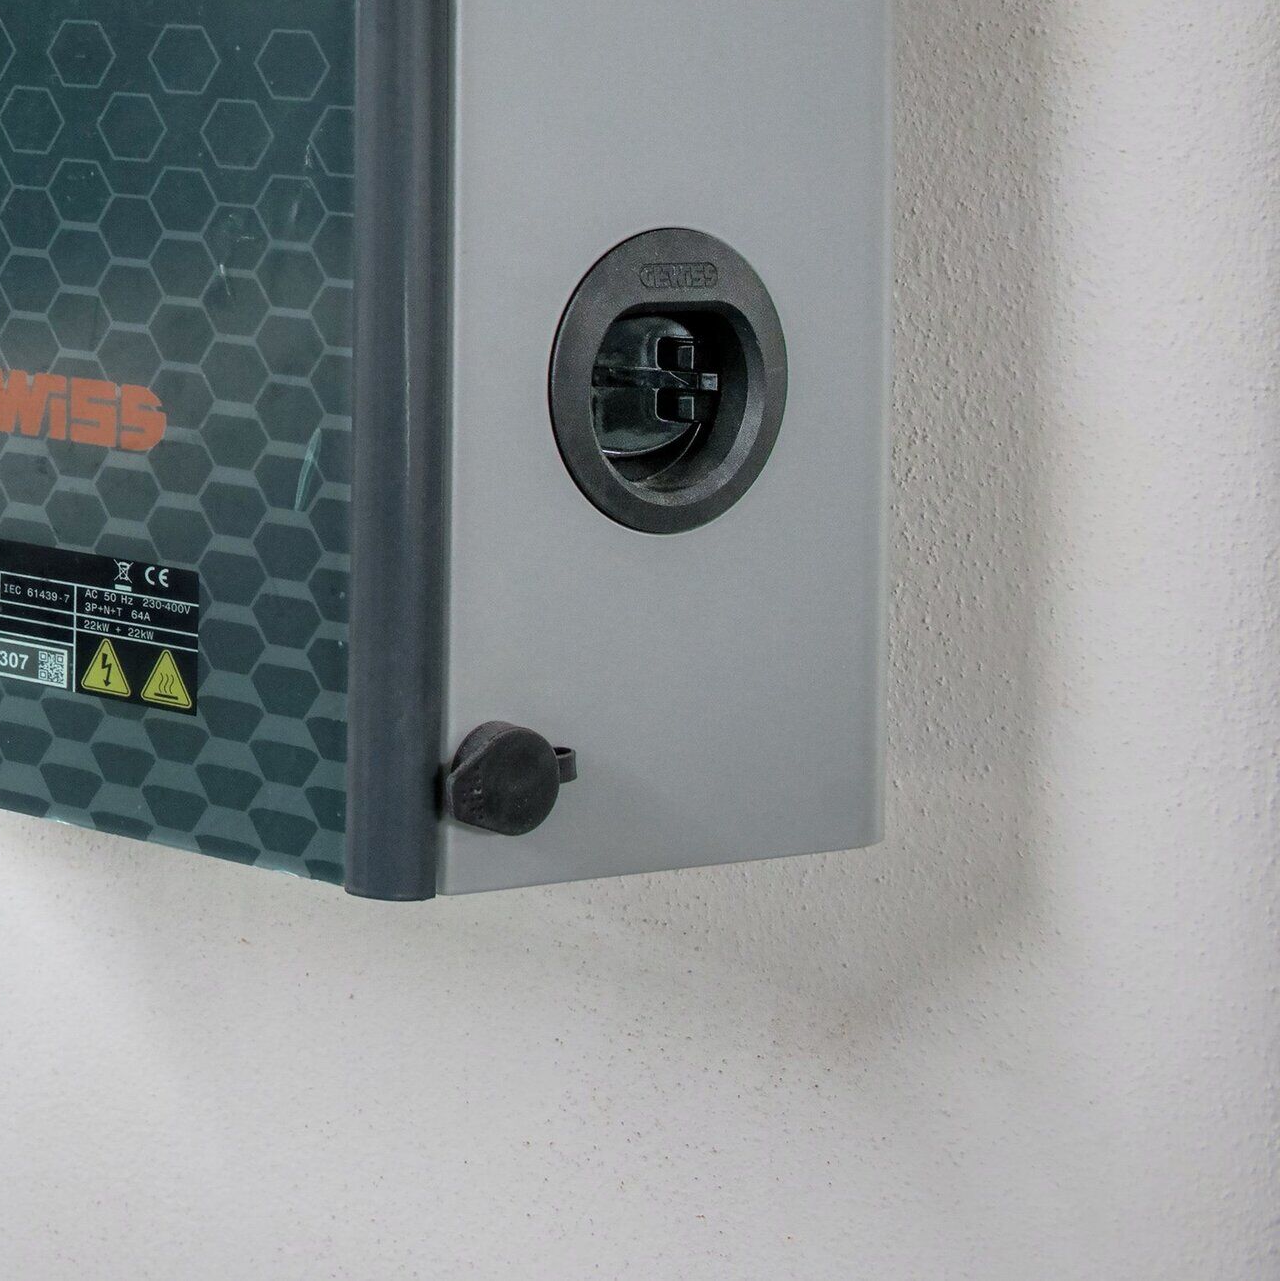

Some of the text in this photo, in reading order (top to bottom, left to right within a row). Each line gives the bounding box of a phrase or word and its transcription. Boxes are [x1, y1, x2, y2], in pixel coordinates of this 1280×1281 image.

[3, 583, 71, 604] IEC 61439-7
[84, 588, 191, 614] AC 50 Hz 230-400V
[84, 601, 151, 622] 3P+N+T 64A
[83, 619, 110, 633] 22kW
[127, 627, 155, 641] 22kW
